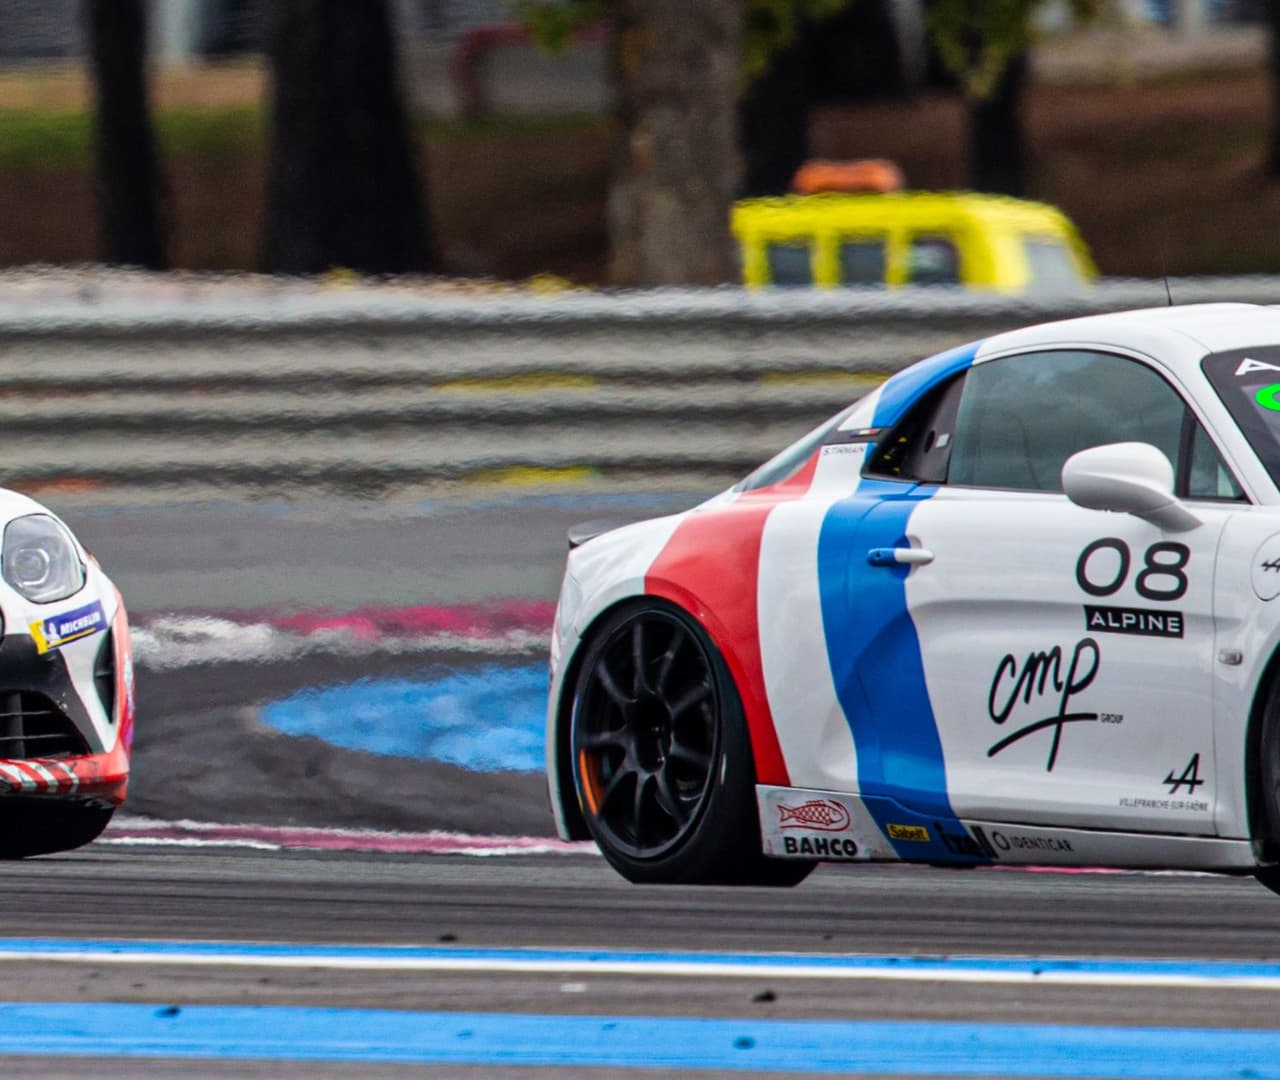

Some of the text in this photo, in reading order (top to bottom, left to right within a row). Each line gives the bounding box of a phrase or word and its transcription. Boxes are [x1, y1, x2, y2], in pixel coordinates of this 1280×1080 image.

[1075, 537, 1191, 601] 08
[60, 611, 101, 636] MICHELIN
[1090, 611, 1181, 633] ALPINE
[784, 836, 858, 857] BAHCO
[1009, 836, 1075, 853] IDENTICAR
